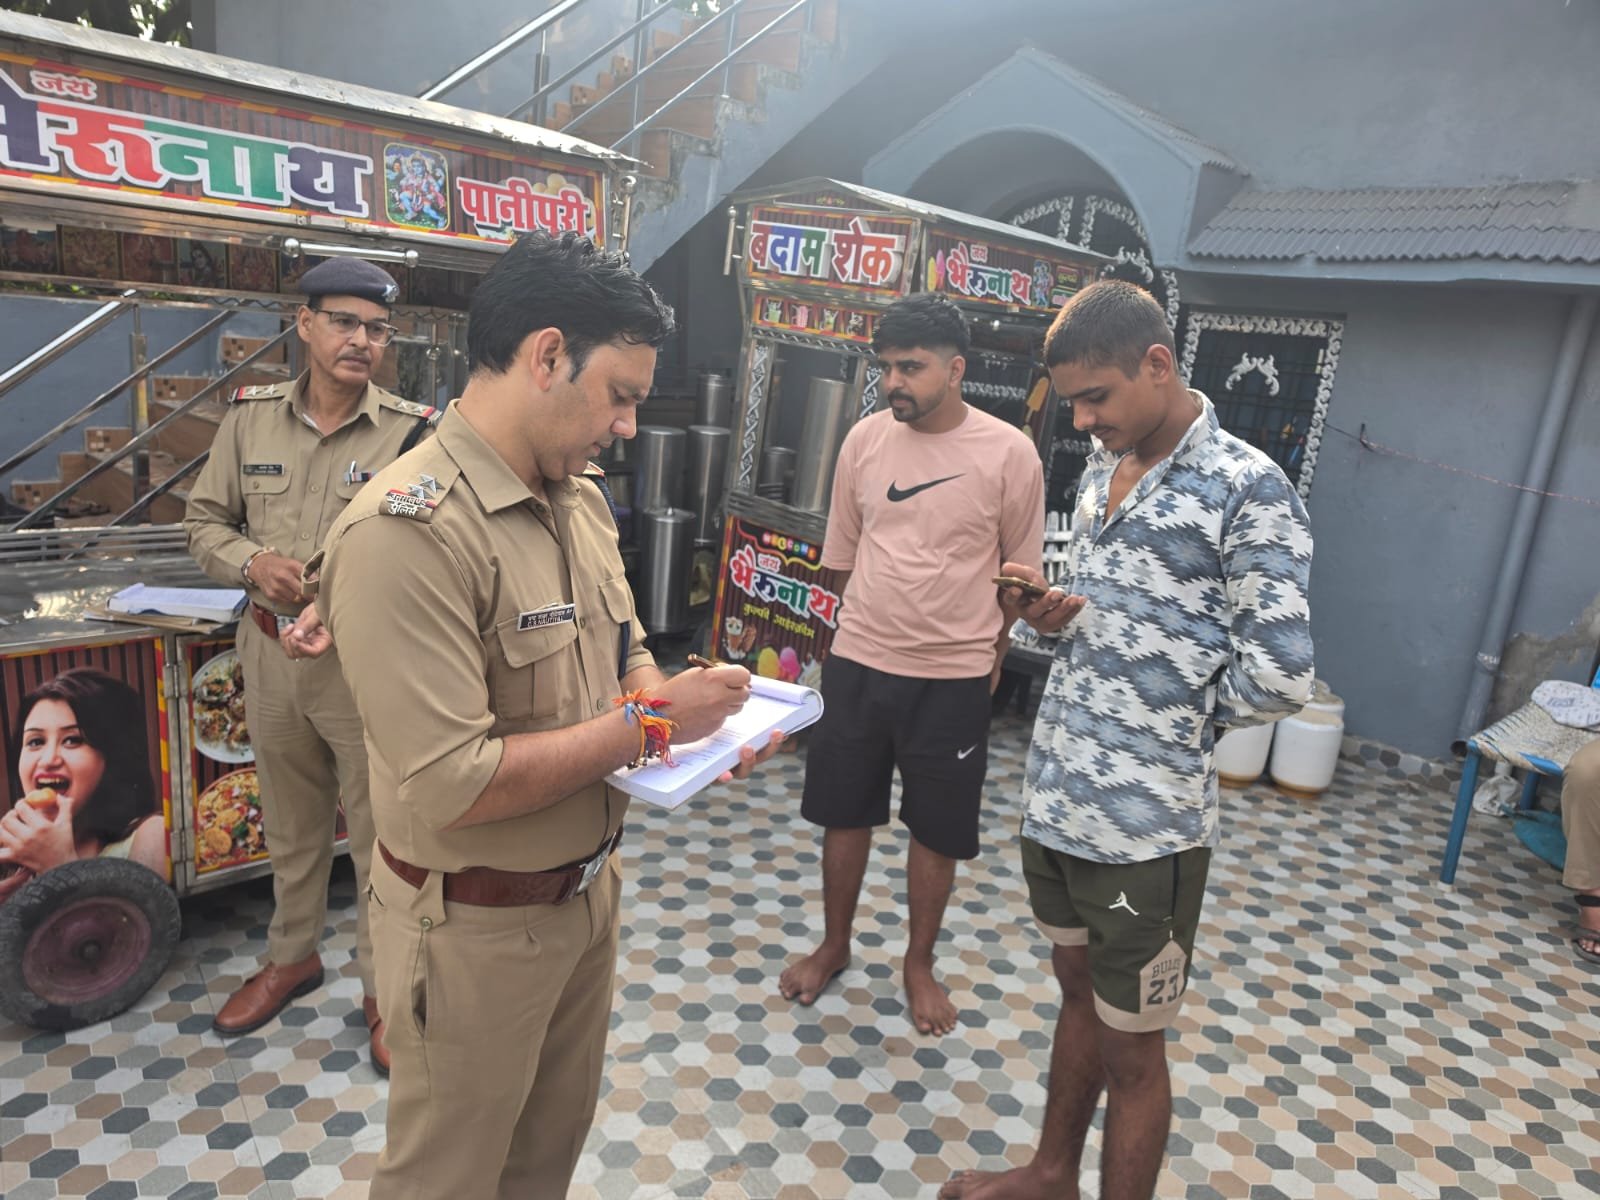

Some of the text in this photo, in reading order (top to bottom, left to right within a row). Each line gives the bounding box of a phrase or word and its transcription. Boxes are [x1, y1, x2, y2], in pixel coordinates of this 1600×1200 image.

[33, 72, 95, 99] जय
[751, 217, 897, 284] बदाम शेक
[971, 245, 988, 262] जय
[758, 554, 781, 572] जय
